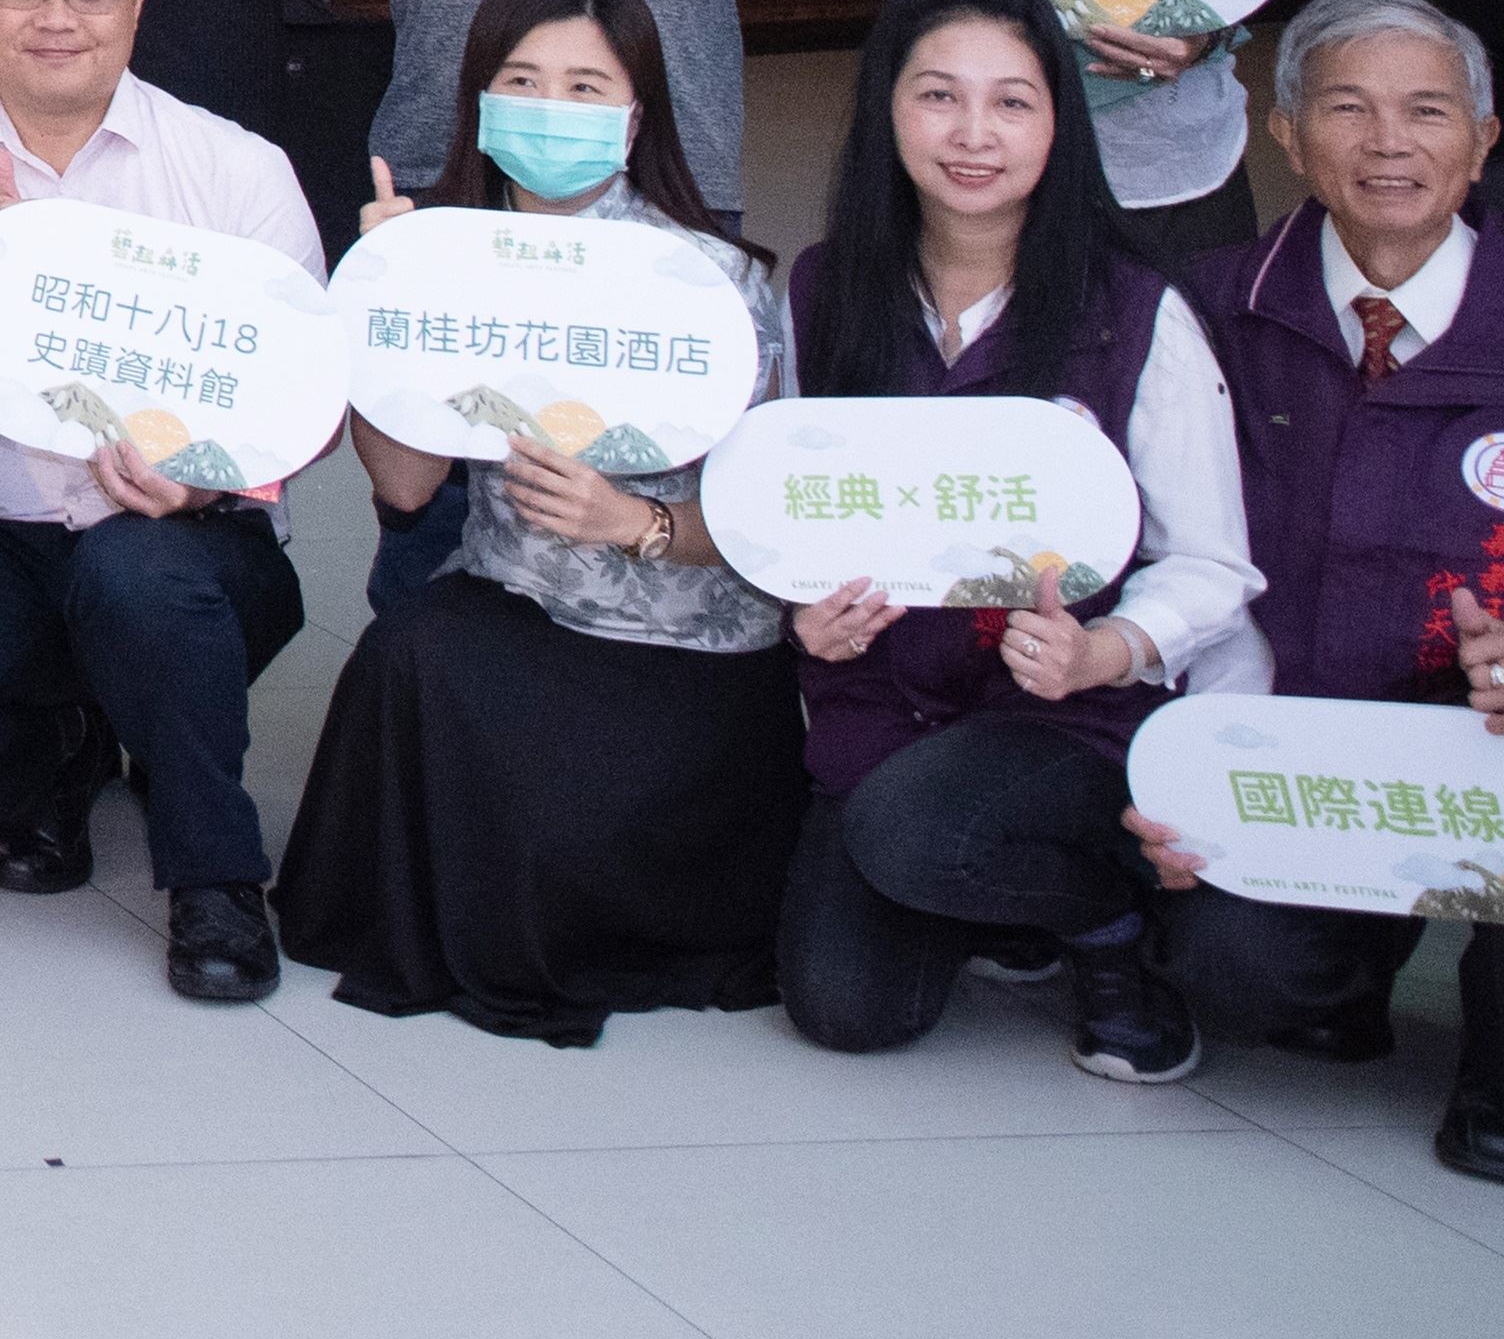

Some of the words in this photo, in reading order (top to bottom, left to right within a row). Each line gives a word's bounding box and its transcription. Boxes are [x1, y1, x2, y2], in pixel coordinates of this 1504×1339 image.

[31, 274, 258, 355] 昭和十八j18
[368, 306, 711, 376] 蘭桂坊花園酒店
[27, 330, 239, 410] 史蹟資料館
[1228, 768, 1504, 843] 國際連線
[1241, 875, 1289, 889] CHIAYI
